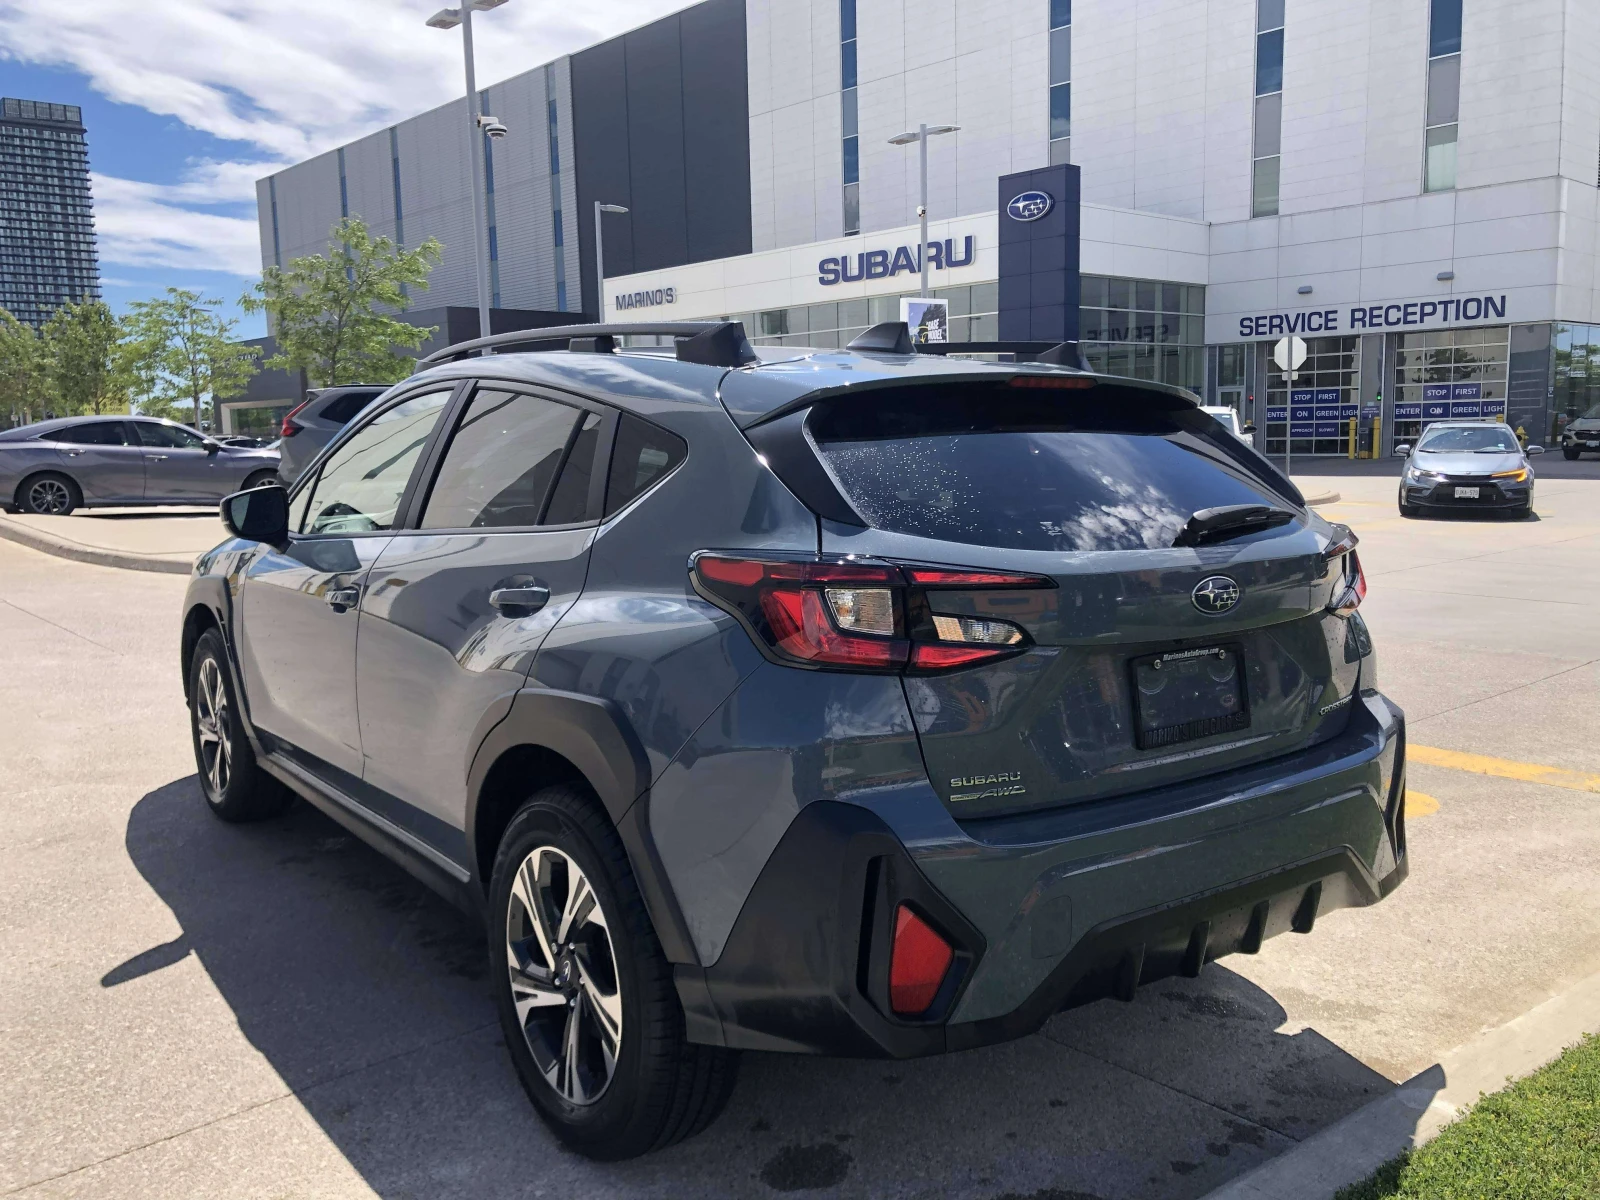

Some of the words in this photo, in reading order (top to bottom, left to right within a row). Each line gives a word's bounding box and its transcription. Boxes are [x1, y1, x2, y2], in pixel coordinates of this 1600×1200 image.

[818, 235, 974, 286] SUBARU
[615, 287, 675, 311] MARINO'S
[1239, 309, 1338, 337] SERVICE
[1350, 295, 1507, 329] RECEPTION
[1427, 389, 1447, 397] STOP
[950, 771, 1021, 787] SUBARU
[979, 785, 1026, 799] AWD
